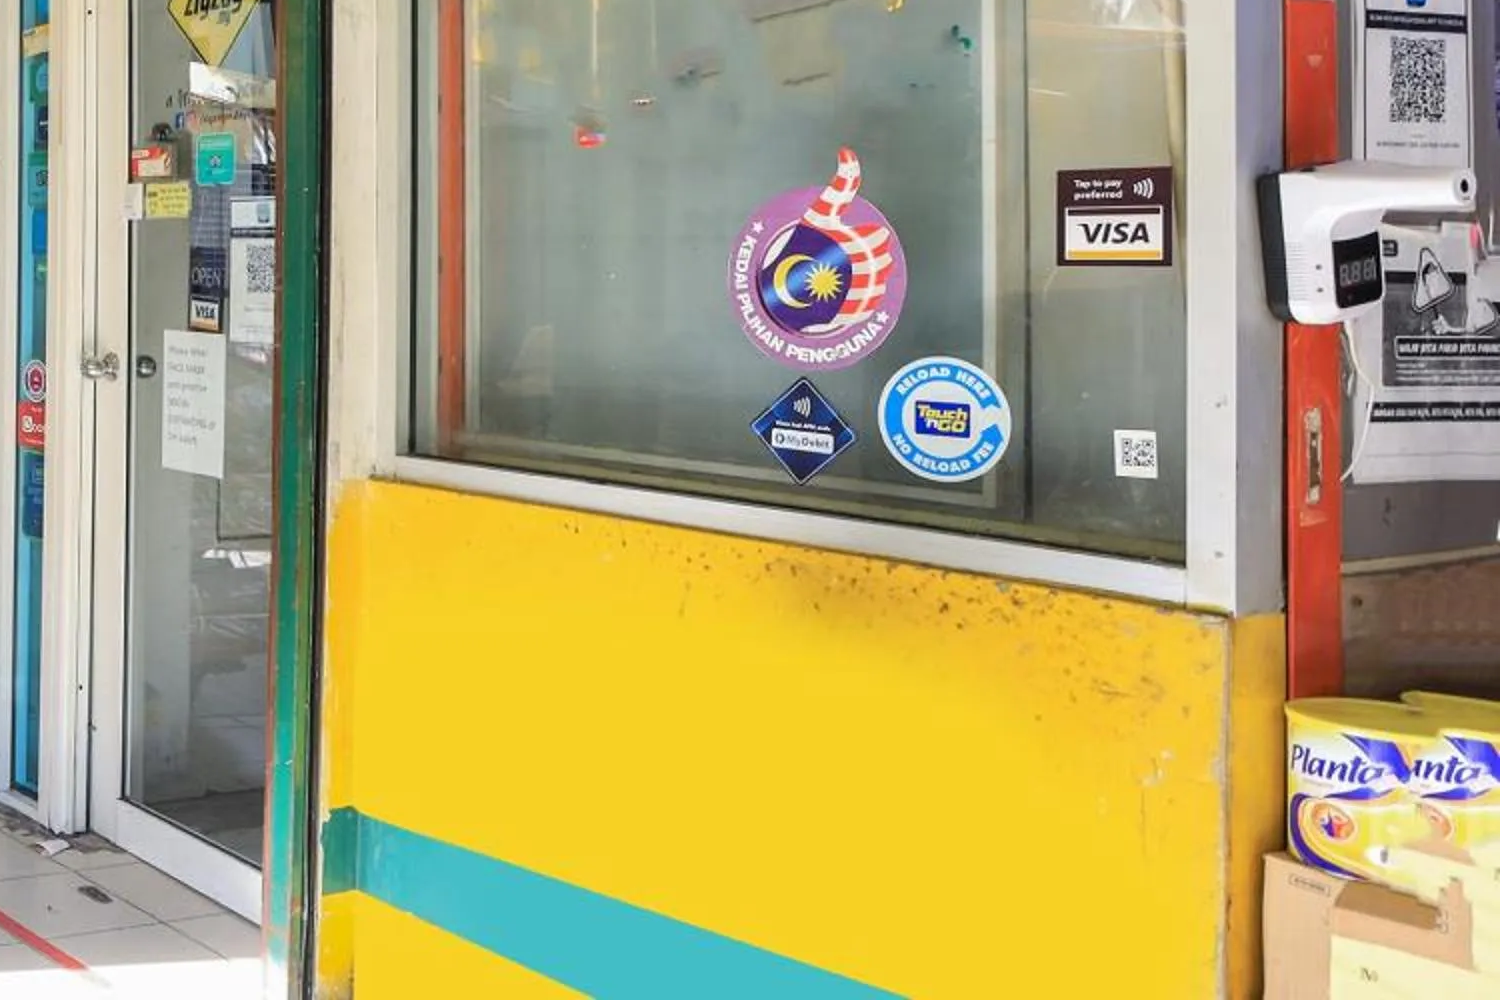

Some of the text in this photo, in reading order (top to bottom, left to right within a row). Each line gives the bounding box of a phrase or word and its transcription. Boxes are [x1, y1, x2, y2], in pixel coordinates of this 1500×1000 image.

[1073, 179, 1122, 189] Tap to pay
[1073, 190, 1124, 201] preferred
[1077, 221, 1151, 245] VISA
[733, 235, 883, 363] KEDAI PILIHAN PENGGUNA
[895, 367, 992, 400] RELOAD HERE
[917, 404, 968, 422] Touch
[891, 432, 996, 473] NO RELOAD FEE
[1290, 743, 1384, 785] Planta
